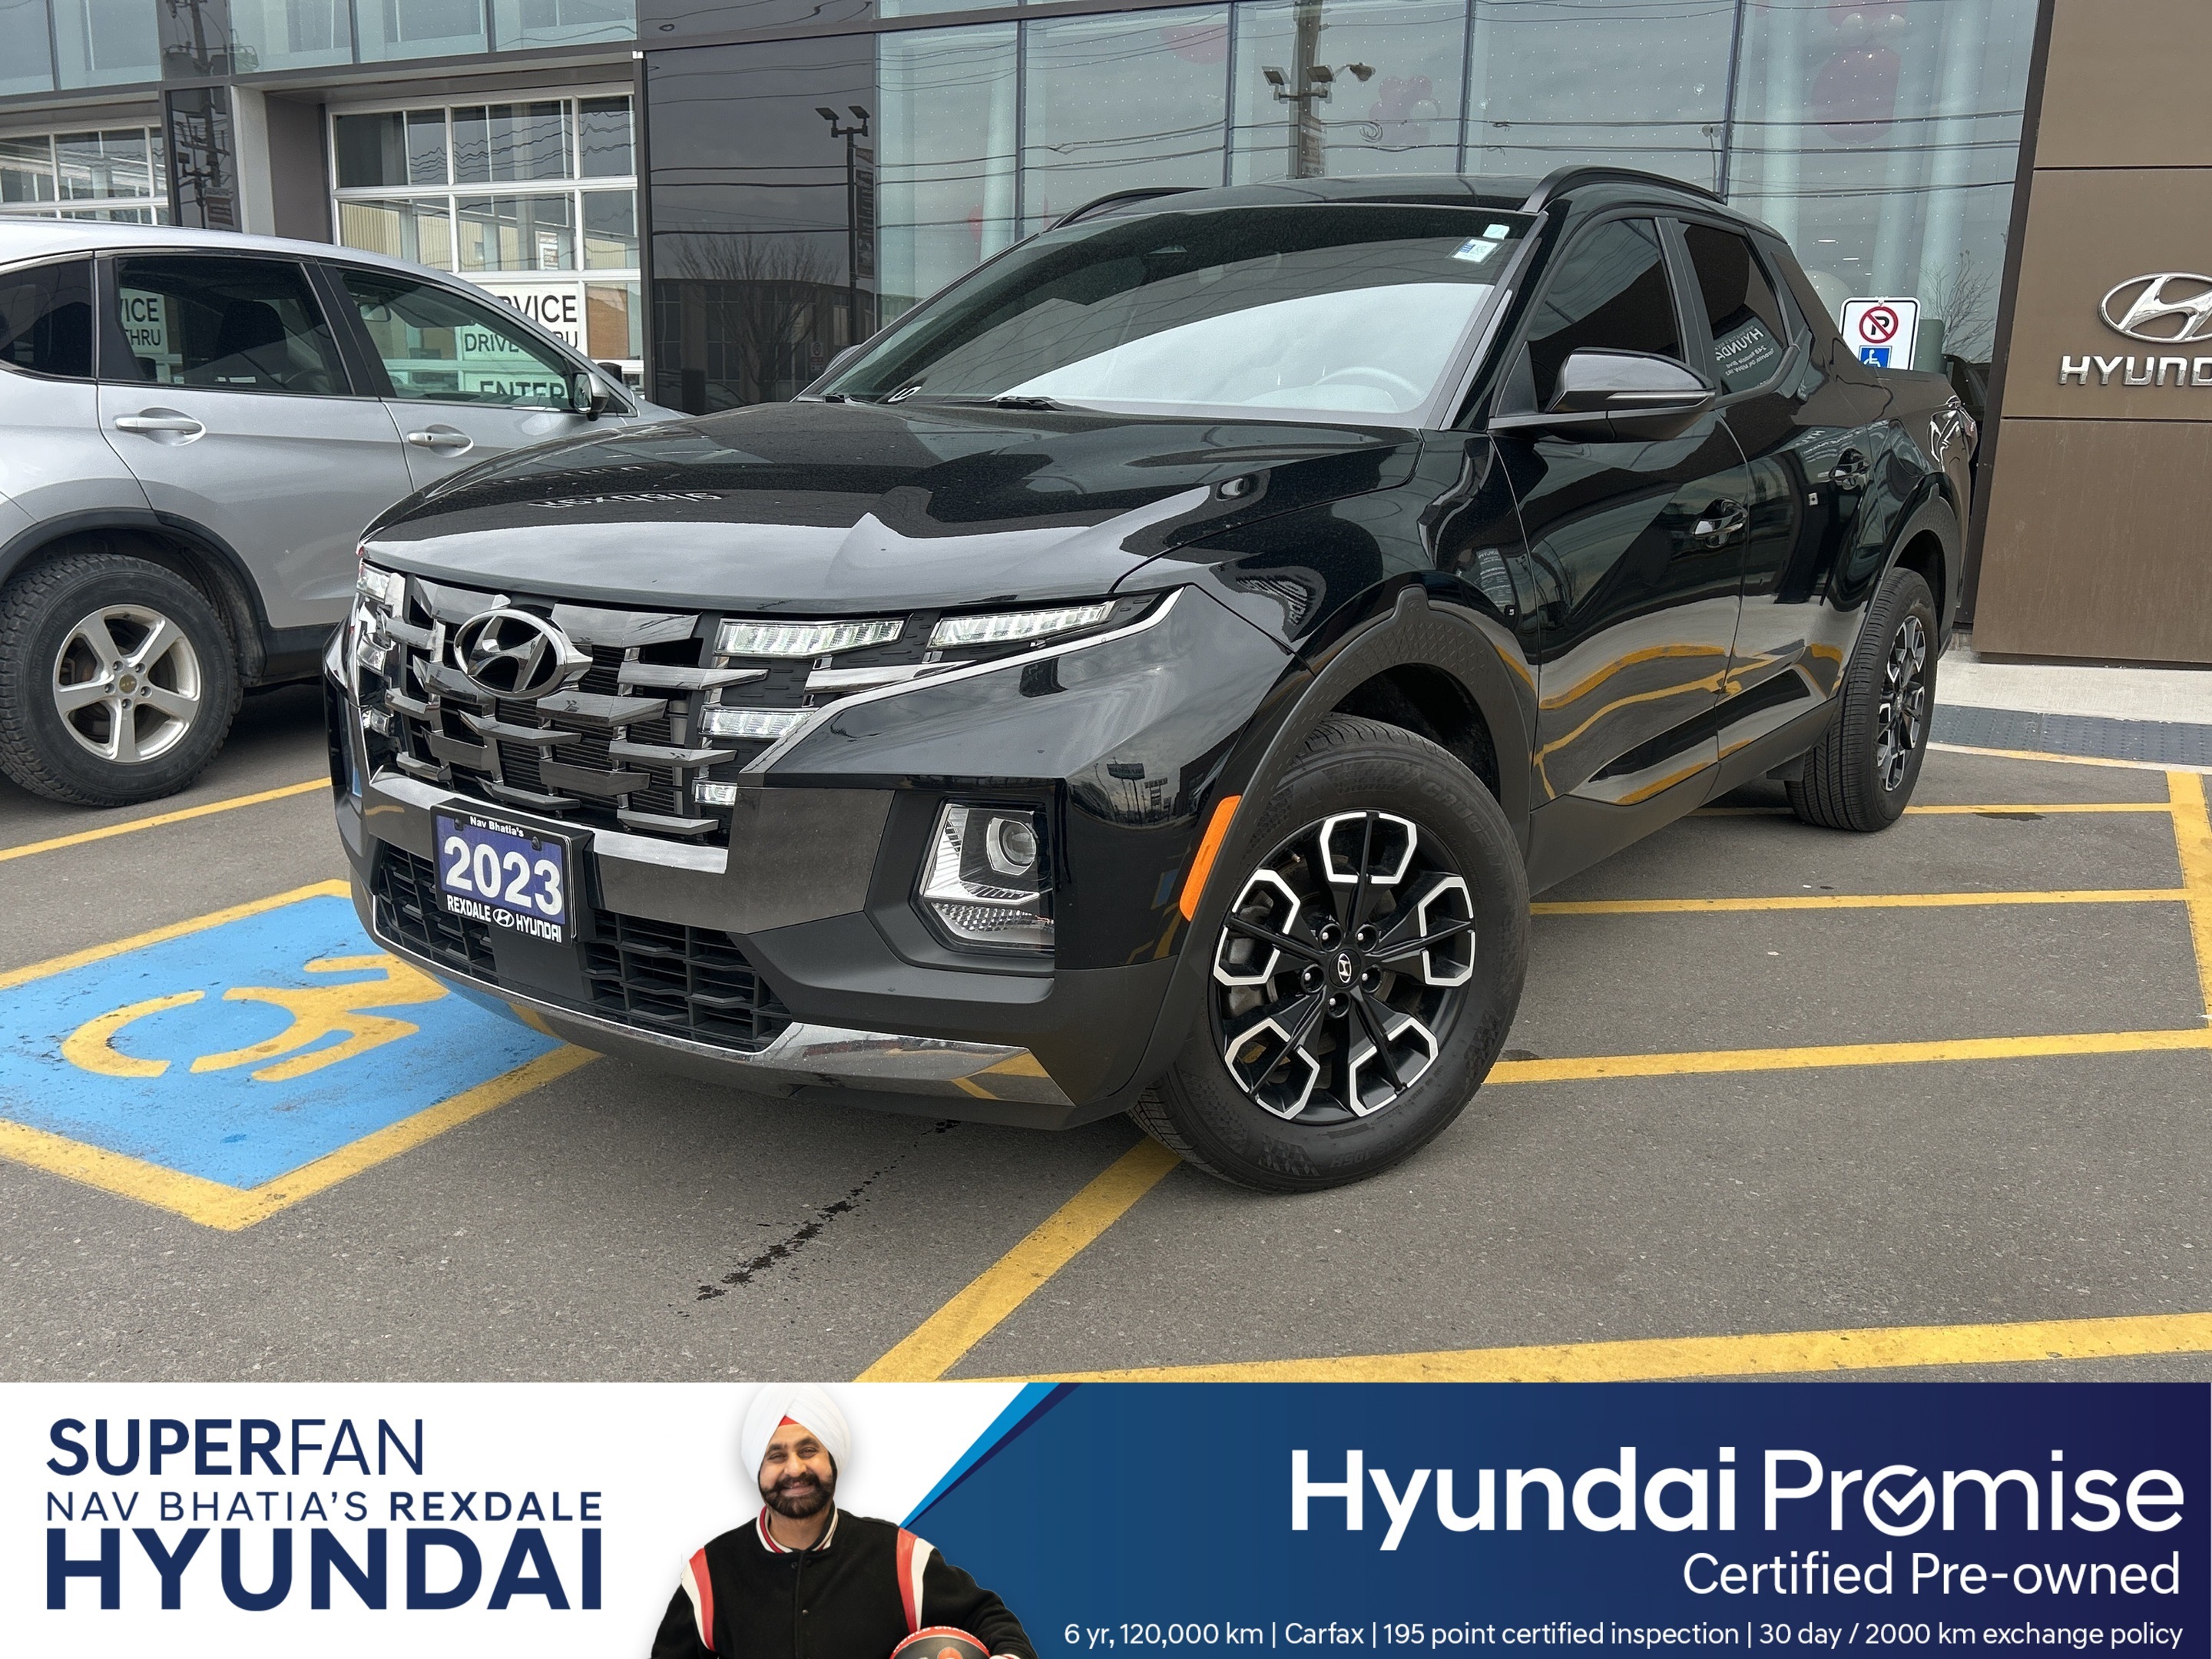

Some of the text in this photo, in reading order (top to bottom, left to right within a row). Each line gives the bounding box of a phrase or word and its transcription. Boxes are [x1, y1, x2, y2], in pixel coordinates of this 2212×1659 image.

[469, 816, 525, 837] Nav Bhatia's
[444, 836, 563, 916] 2023
[446, 894, 563, 943] REXDALE HYUNDAI
